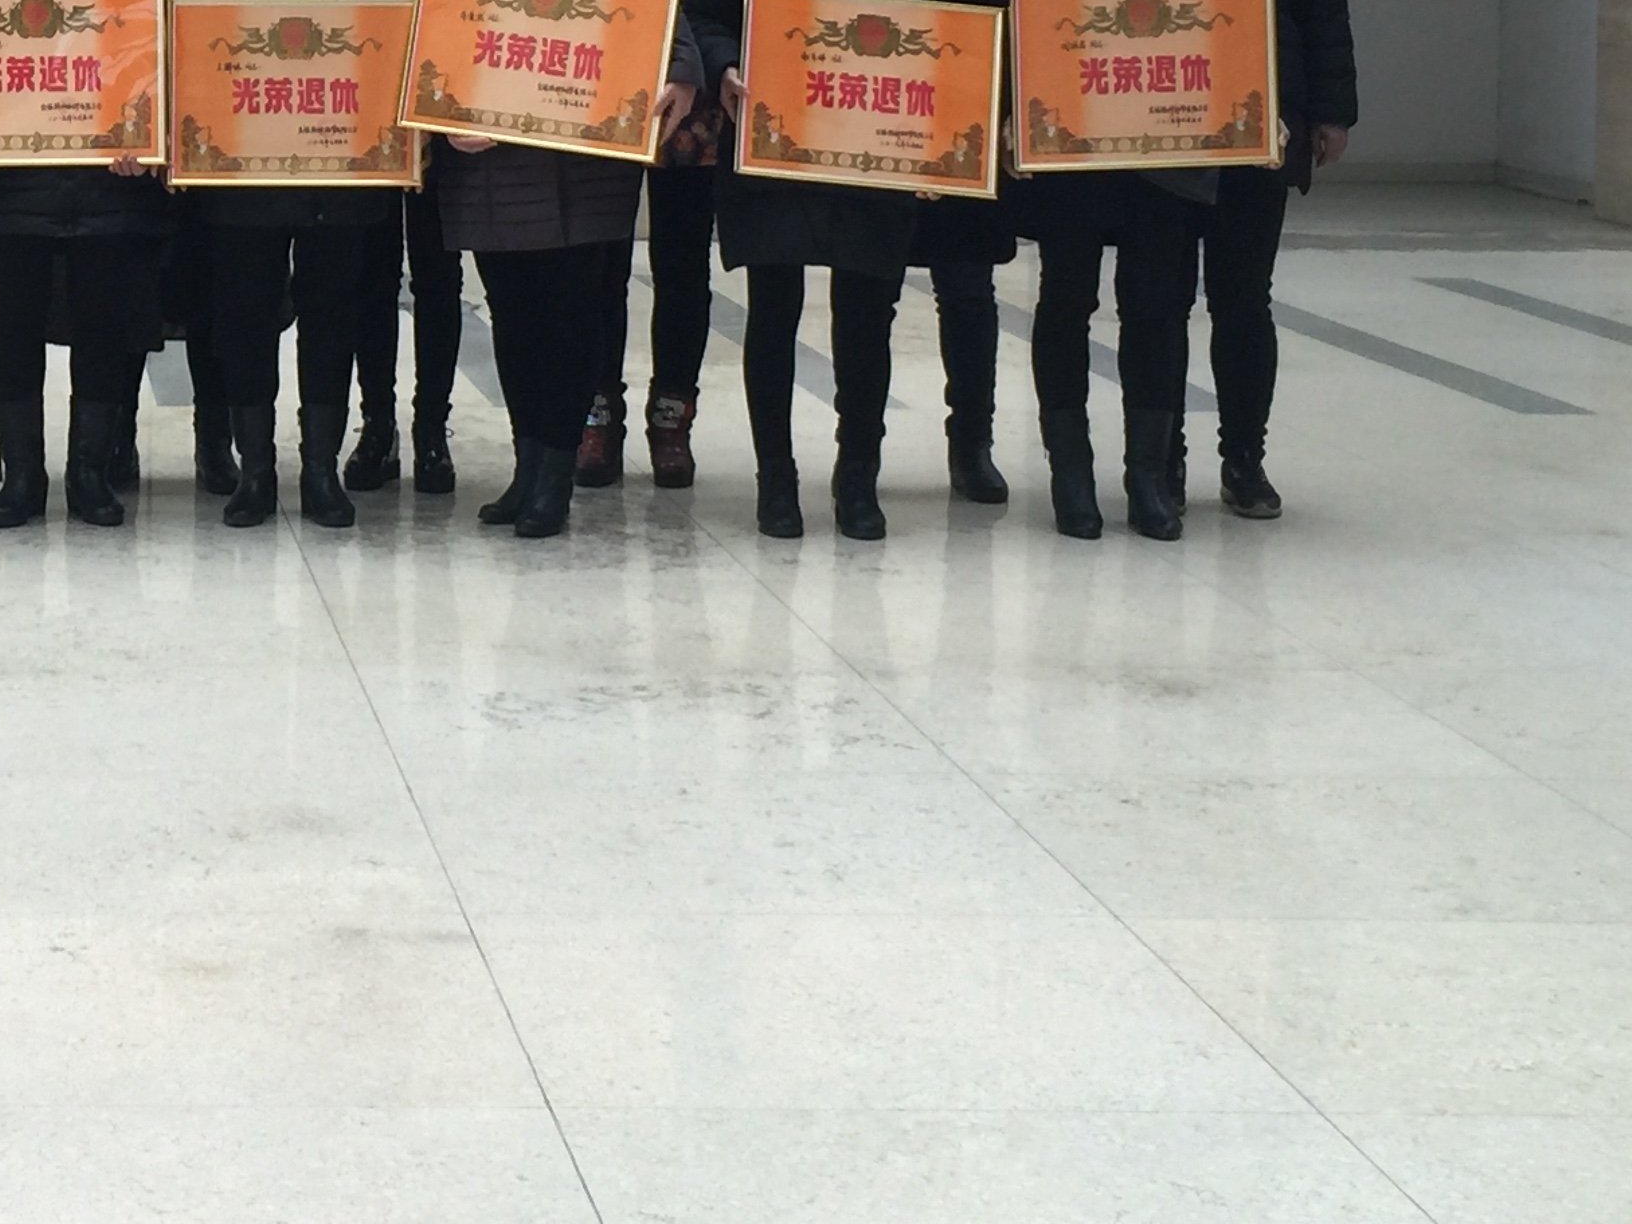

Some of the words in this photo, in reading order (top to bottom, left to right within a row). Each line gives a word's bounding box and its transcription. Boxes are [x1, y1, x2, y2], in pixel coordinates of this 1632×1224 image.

[474, 32, 602, 79] 光荣退休
[1082, 54, 1211, 95] 光荣退休
[235, 78, 359, 115] 光荣退休
[807, 72, 934, 116] 光荣退休
